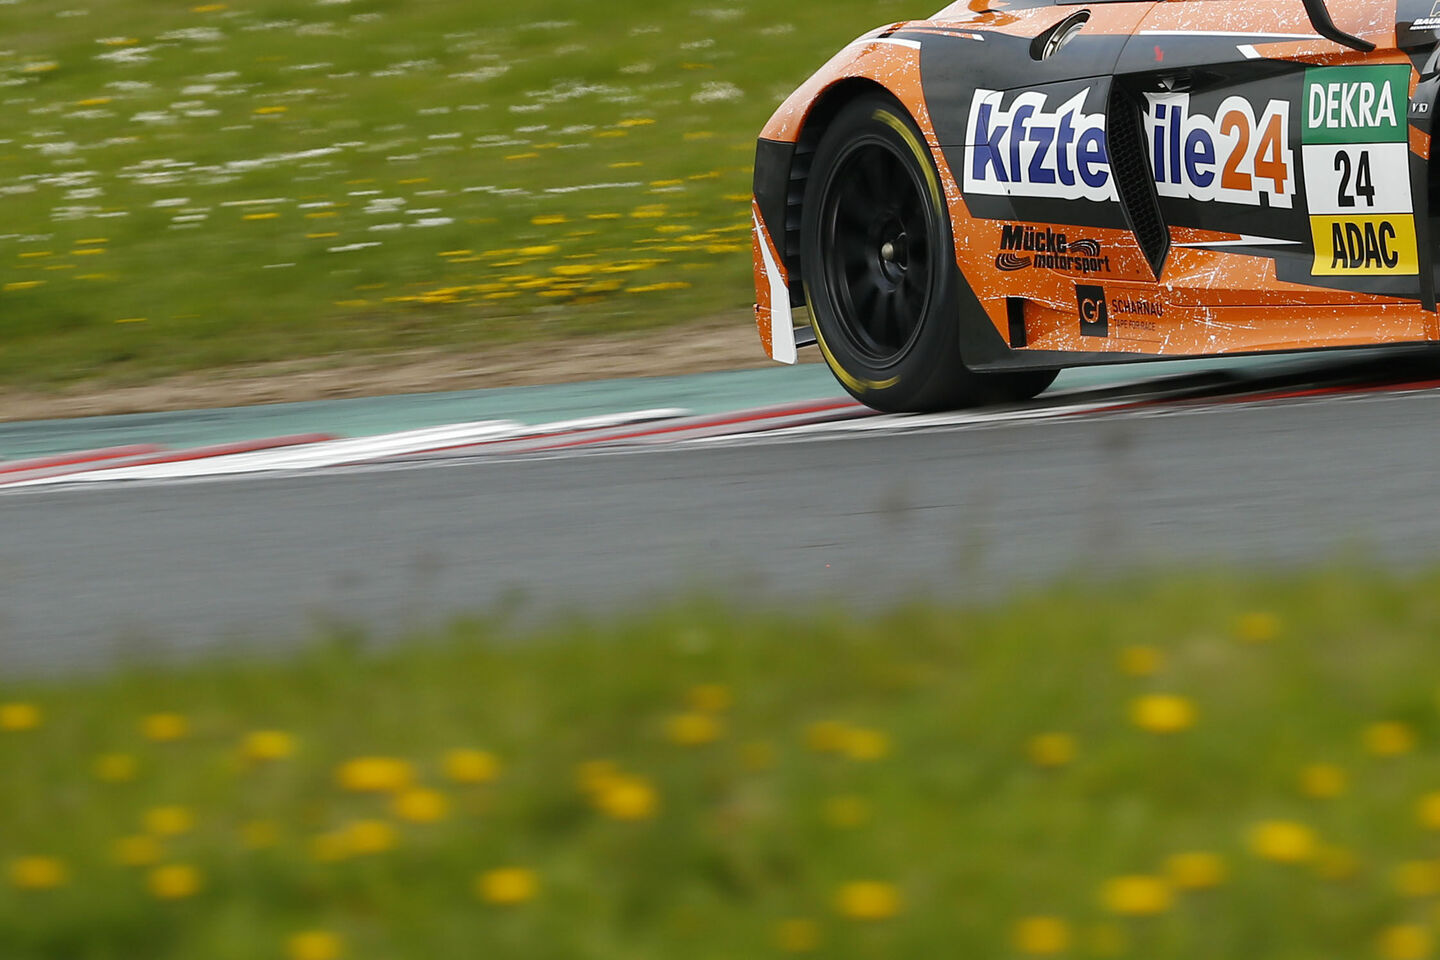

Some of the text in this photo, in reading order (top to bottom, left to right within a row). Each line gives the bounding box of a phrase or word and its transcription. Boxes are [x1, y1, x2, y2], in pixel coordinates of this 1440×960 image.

[1308, 79, 1398, 129] DEKRA
[1334, 149, 1375, 208] 24
[1000, 225, 1068, 253] Mücke
[1331, 220, 1399, 269] ADAC
[1033, 252, 1111, 274] motorsport
[1111, 299, 1164, 317] SCHARNAU
